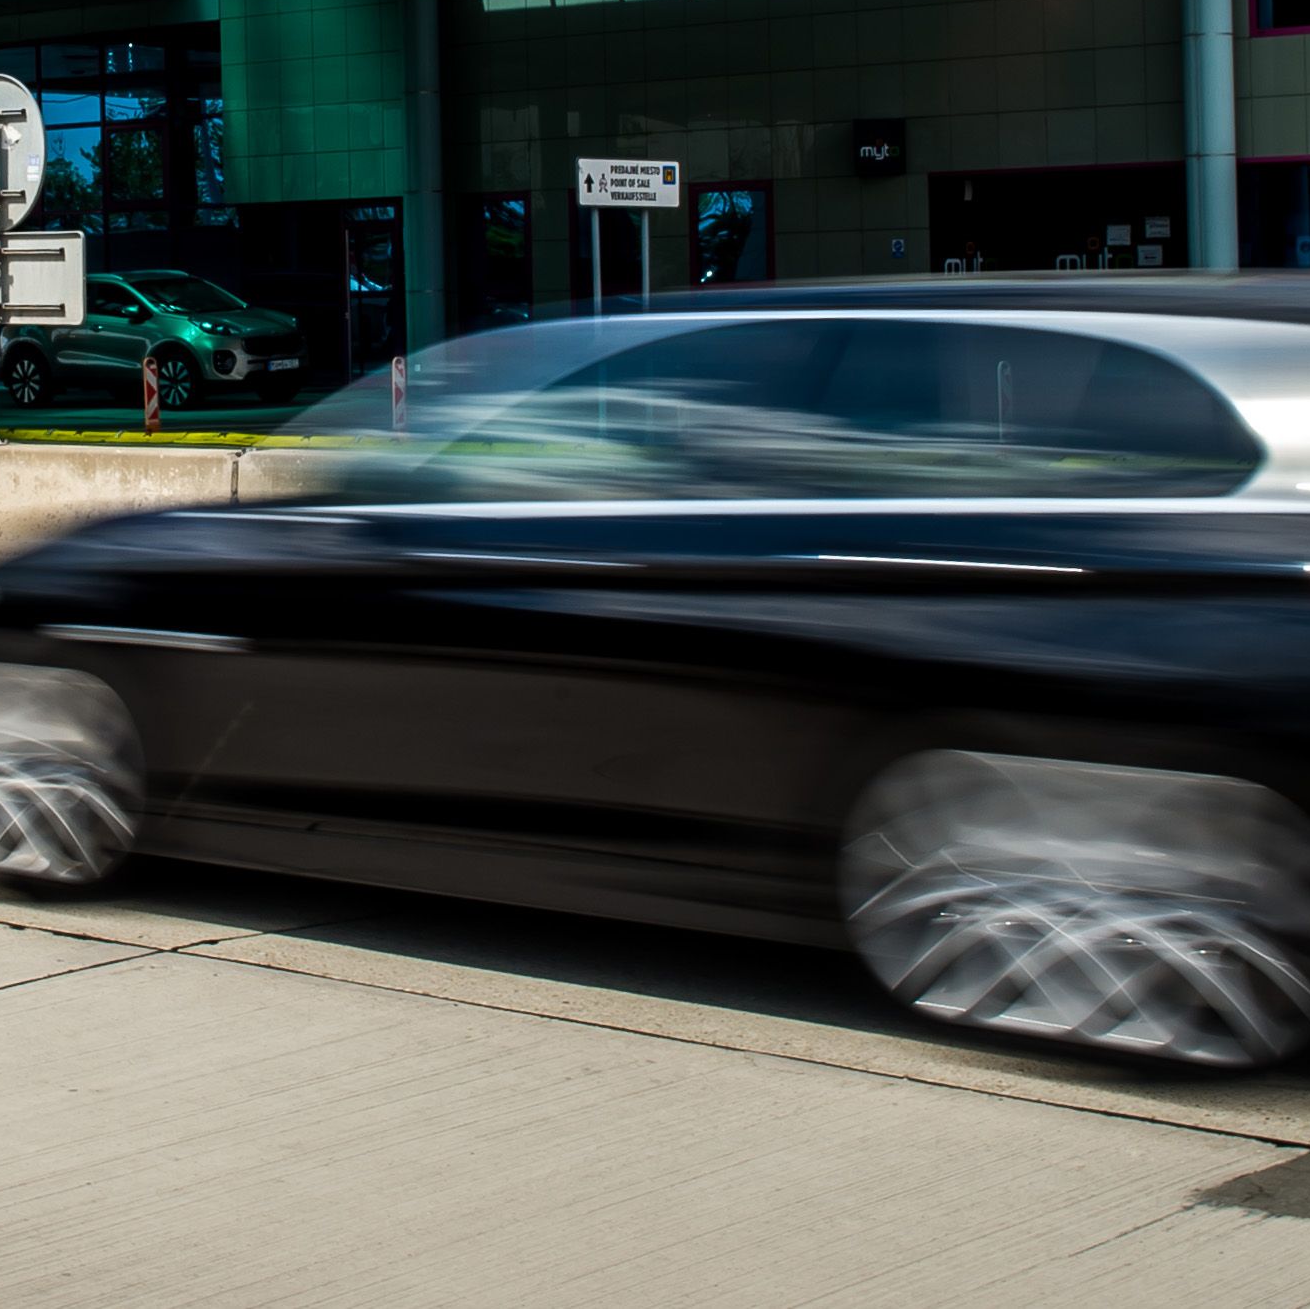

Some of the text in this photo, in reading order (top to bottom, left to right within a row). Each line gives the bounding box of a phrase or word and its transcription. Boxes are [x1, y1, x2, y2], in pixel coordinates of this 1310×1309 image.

[610, 178, 650, 188] POINT OF SALE
